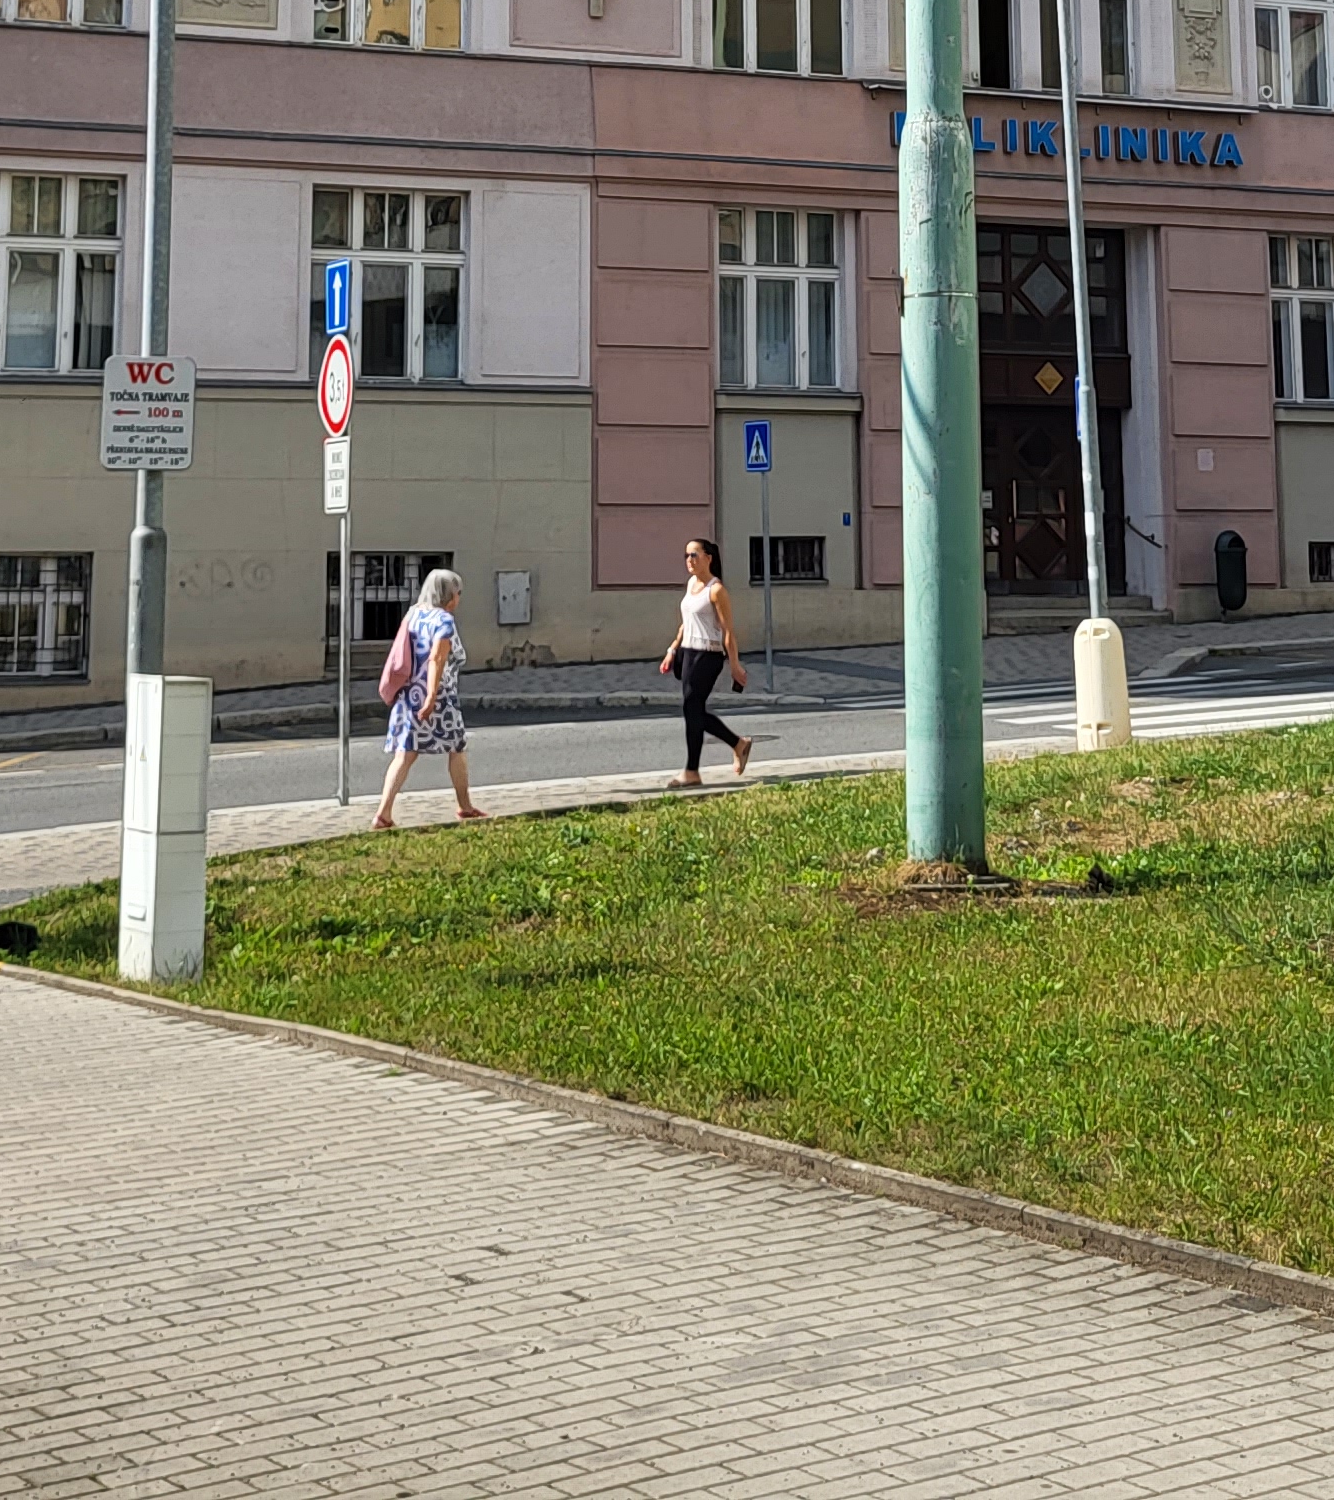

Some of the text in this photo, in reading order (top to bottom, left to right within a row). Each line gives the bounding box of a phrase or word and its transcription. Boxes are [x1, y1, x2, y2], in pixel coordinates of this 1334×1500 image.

[891, 110, 1245, 167] LIKINIKA
[126, 361, 175, 385] WC
[109, 389, 190, 403] TOČNA TRAMVAJE
[147, 406, 183, 418] 100 m
